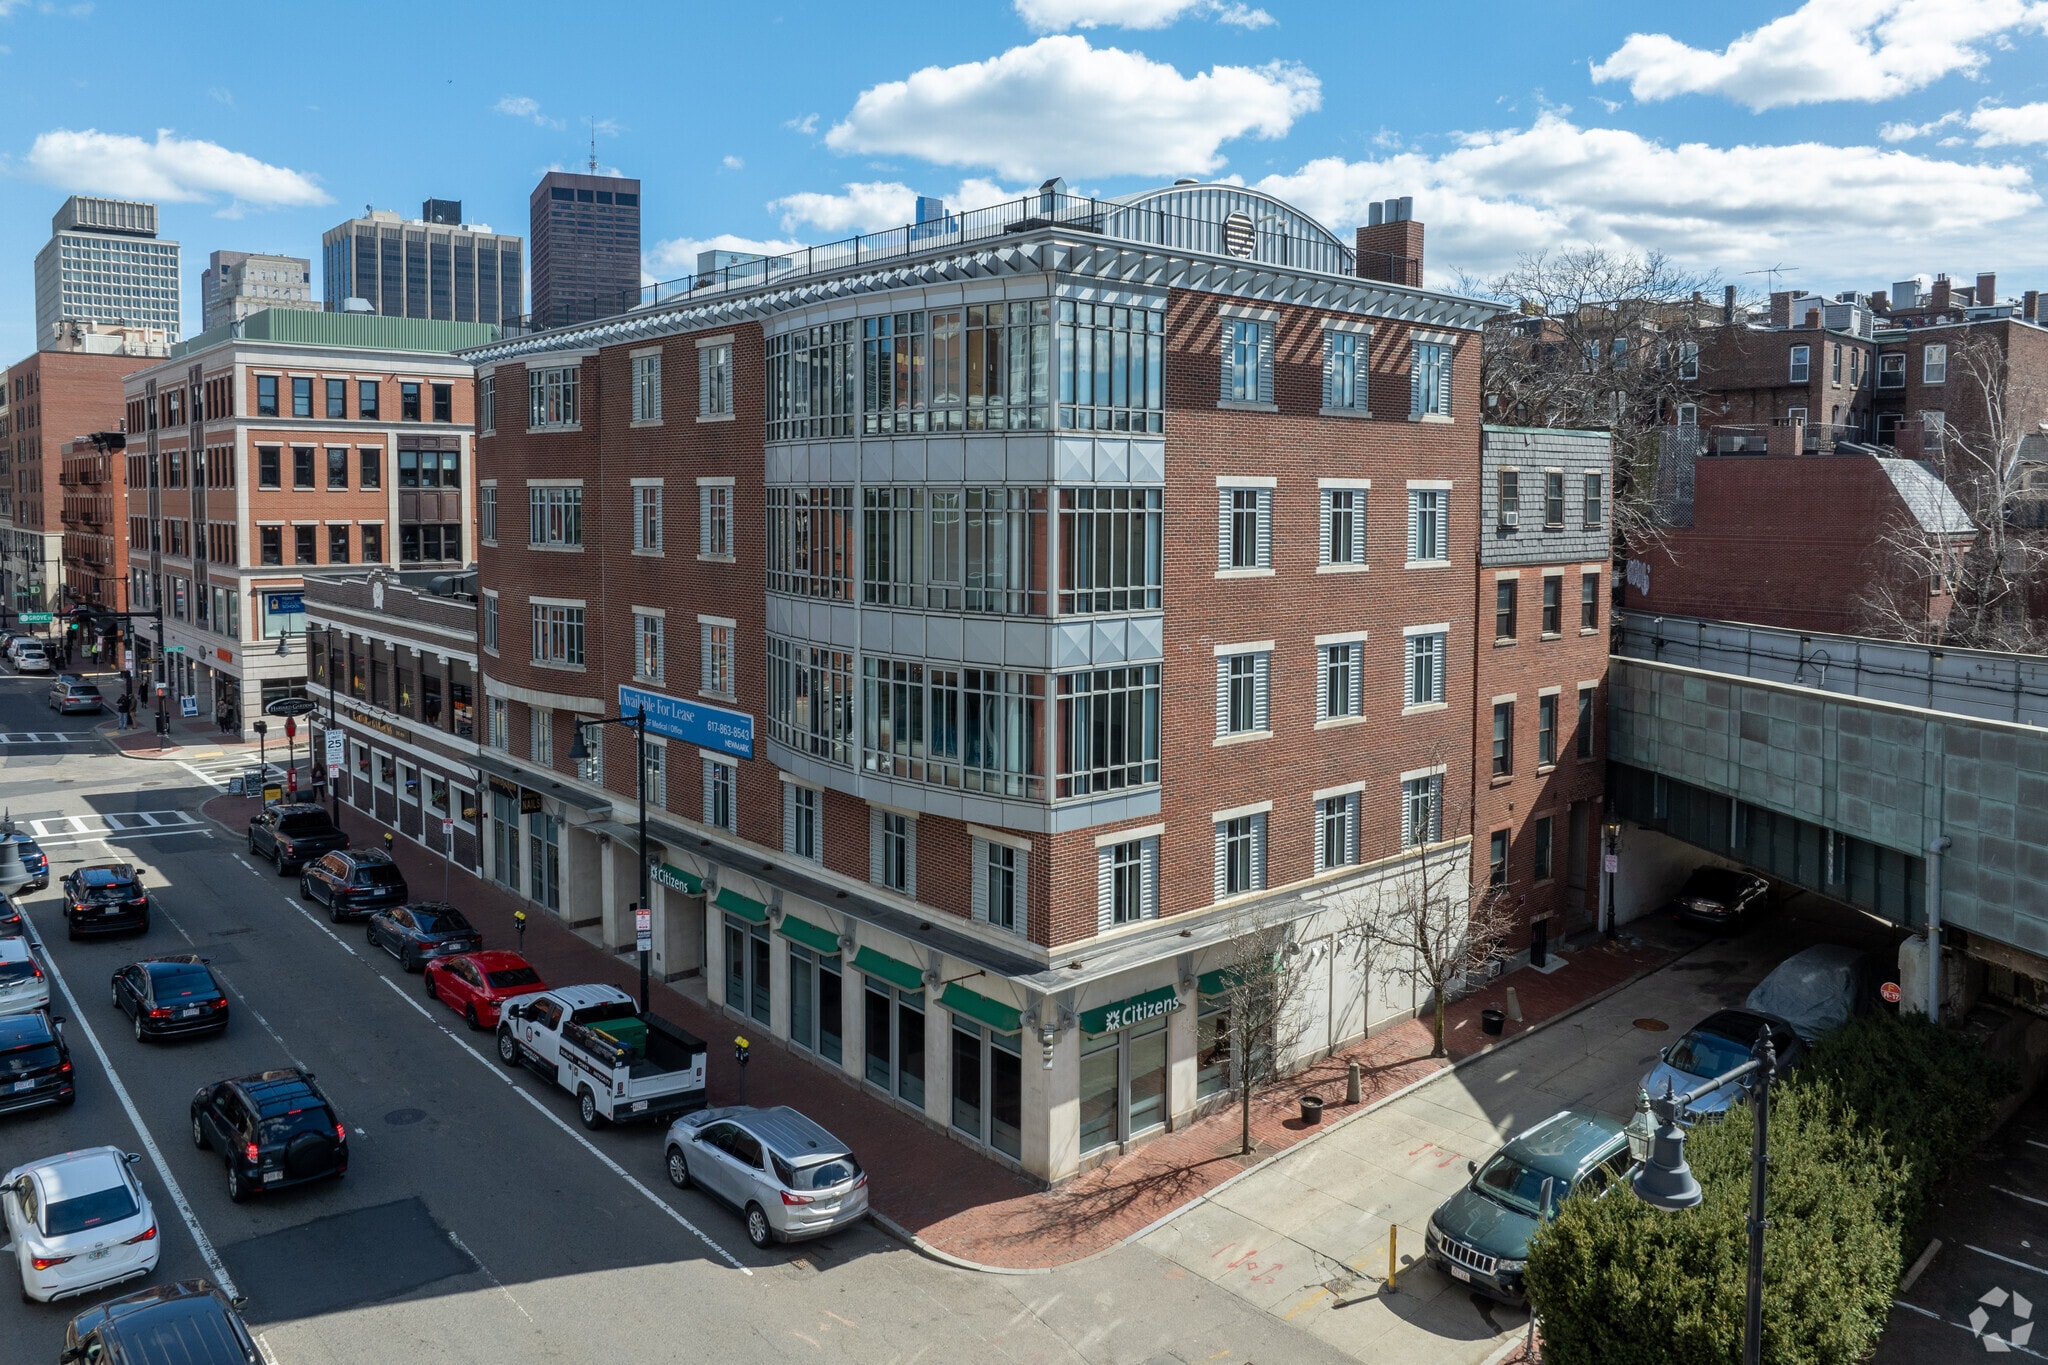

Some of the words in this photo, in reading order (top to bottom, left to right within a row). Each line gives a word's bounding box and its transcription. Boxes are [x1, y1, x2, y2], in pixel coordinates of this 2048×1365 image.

[622, 692, 655, 712] Available
[657, 699, 670, 716] For
[672, 703, 695, 722] Lease
[652, 720, 668, 730] Medical
[670, 724, 683, 735] Office
[708, 720, 750, 740] 617-863-8543
[328, 740, 342, 748] 25
[725, 740, 750, 752] NEWMARK
[522, 798, 541, 810] NAILS
[658, 870, 688, 893] Citizens
[1122, 996, 1179, 1025] Citizens
